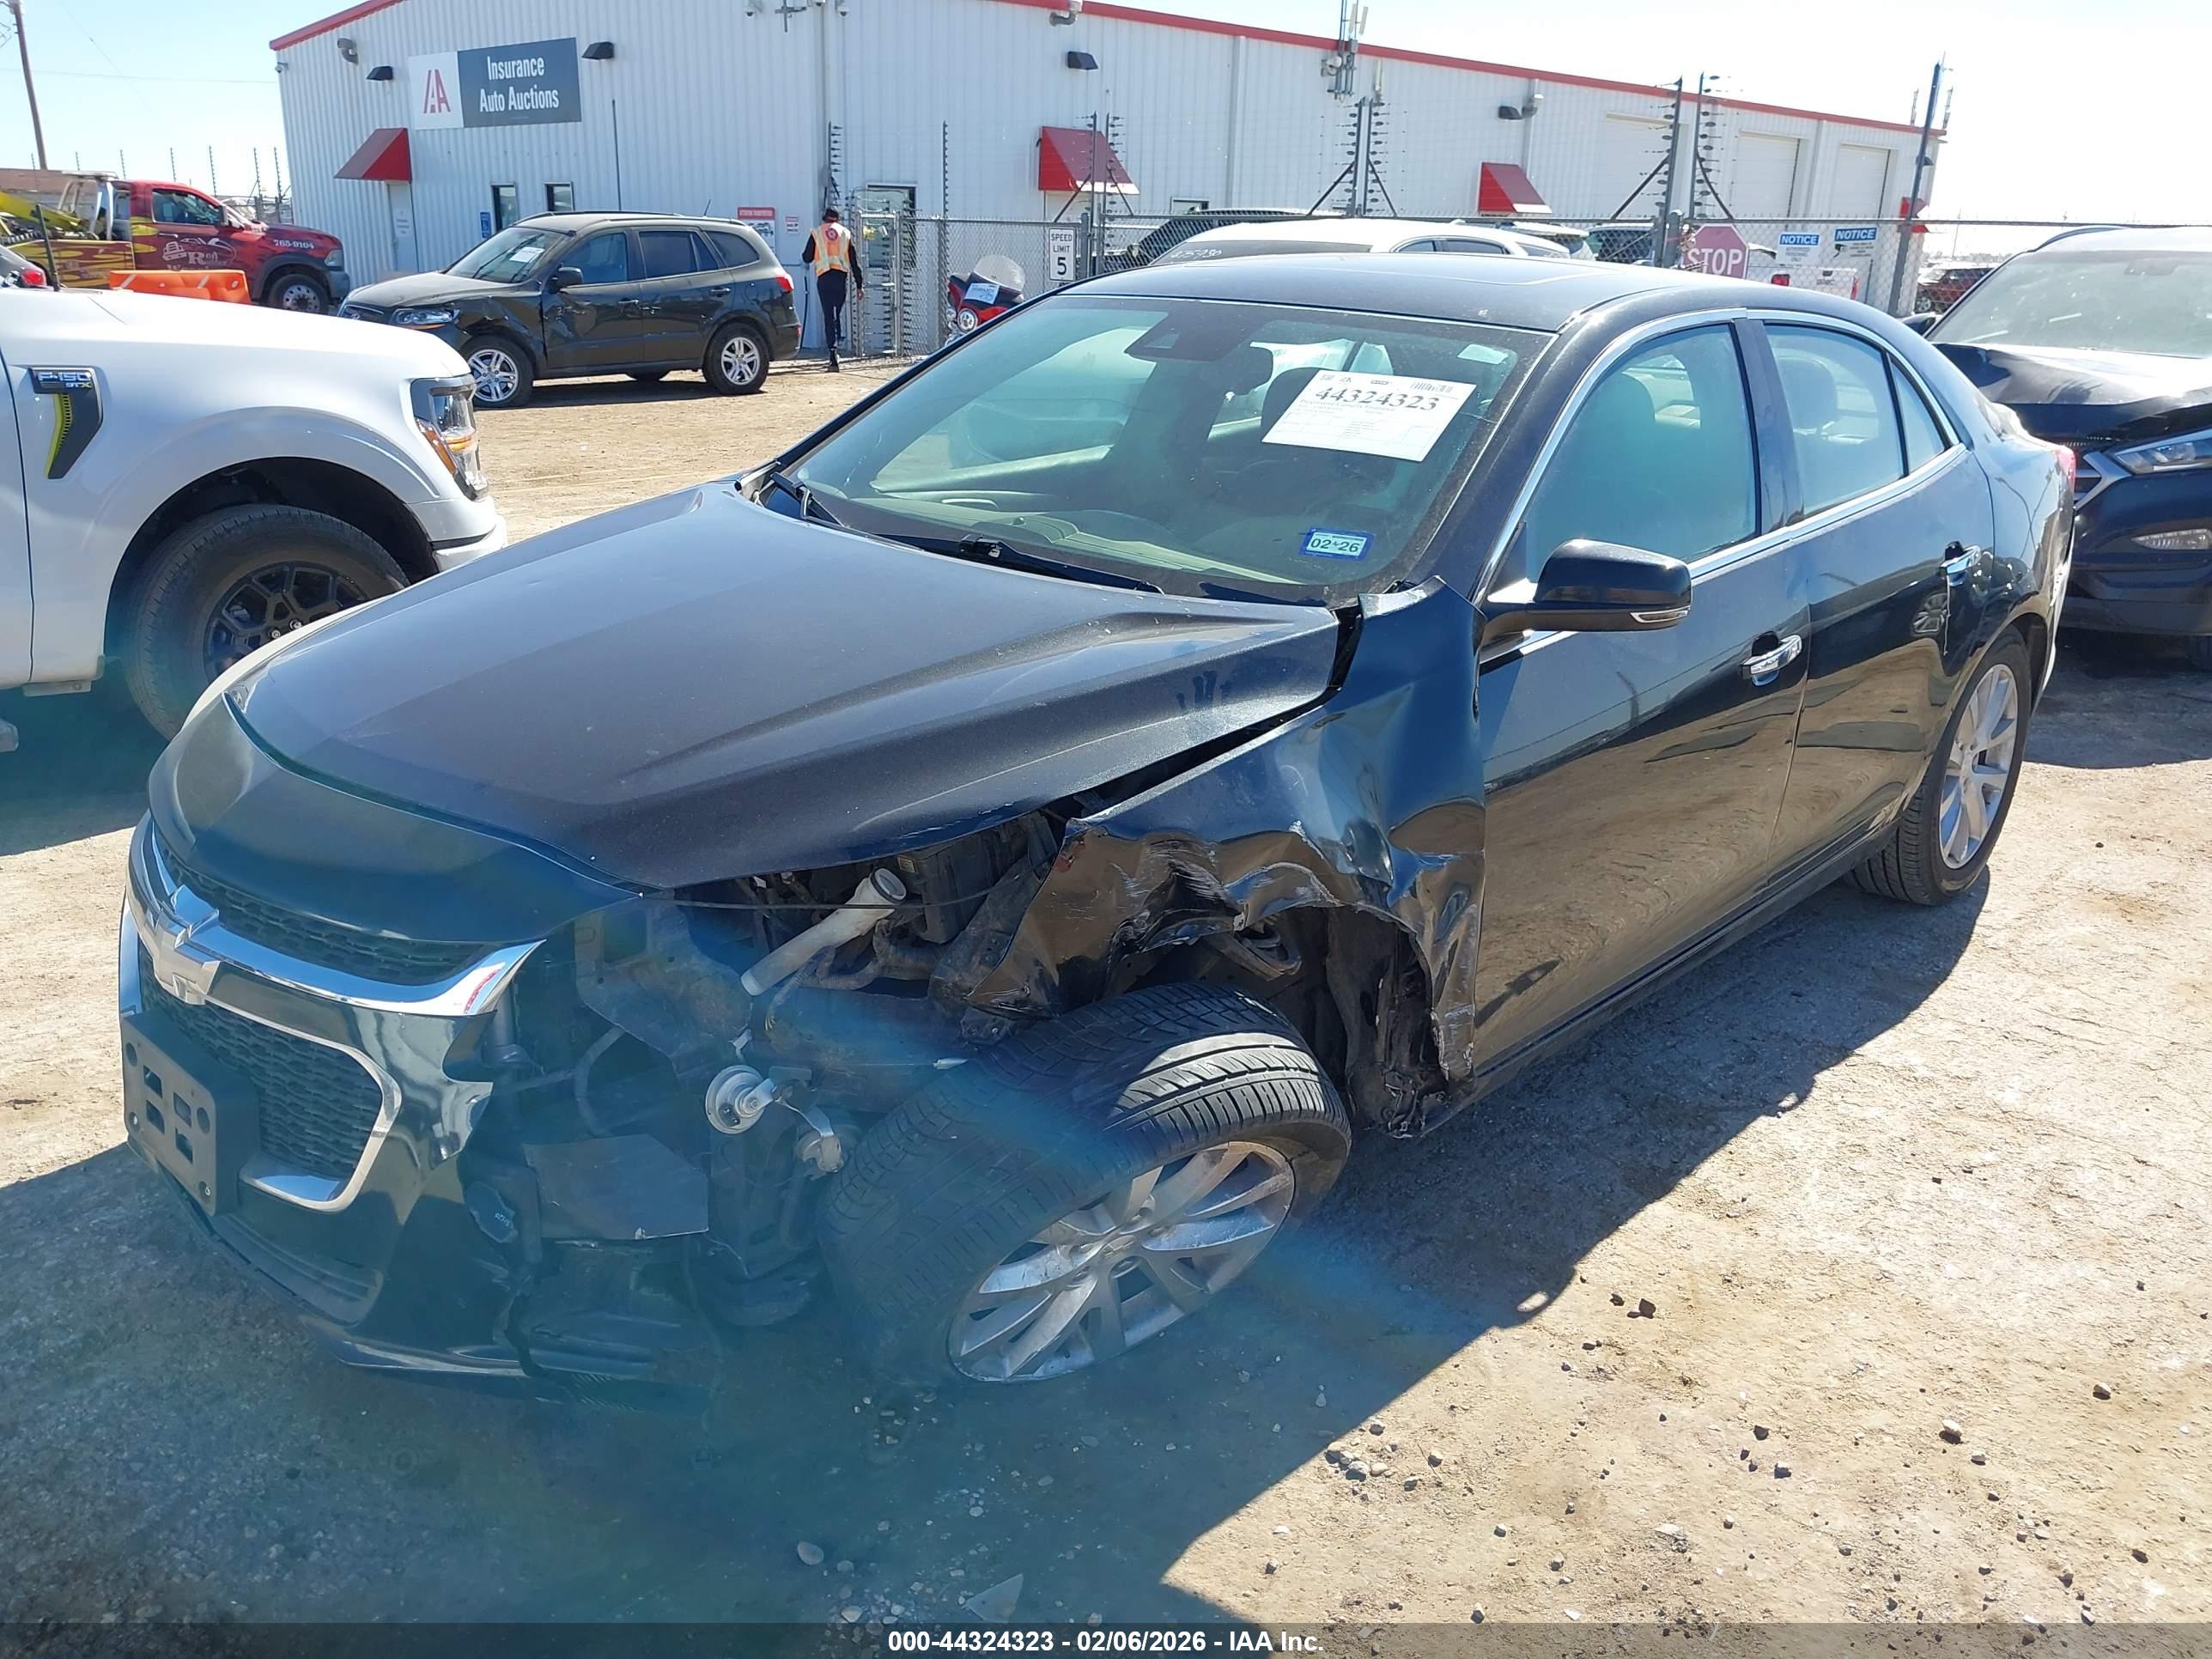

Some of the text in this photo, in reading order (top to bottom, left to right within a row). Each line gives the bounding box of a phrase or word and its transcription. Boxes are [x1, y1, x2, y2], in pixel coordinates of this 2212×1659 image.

[487, 56, 544, 80] Insurance
[480, 84, 560, 112] Auto Auctions
[1781, 235, 1818, 244] NOTICE
[1836, 229, 1876, 240] NOTICE
[1057, 257, 1066, 275] 5
[1687, 247, 1742, 275] STOP
[38, 372, 91, 381] F-150
[1316, 387, 1440, 411] 44324323
[1310, 538, 1360, 553] 02 26
